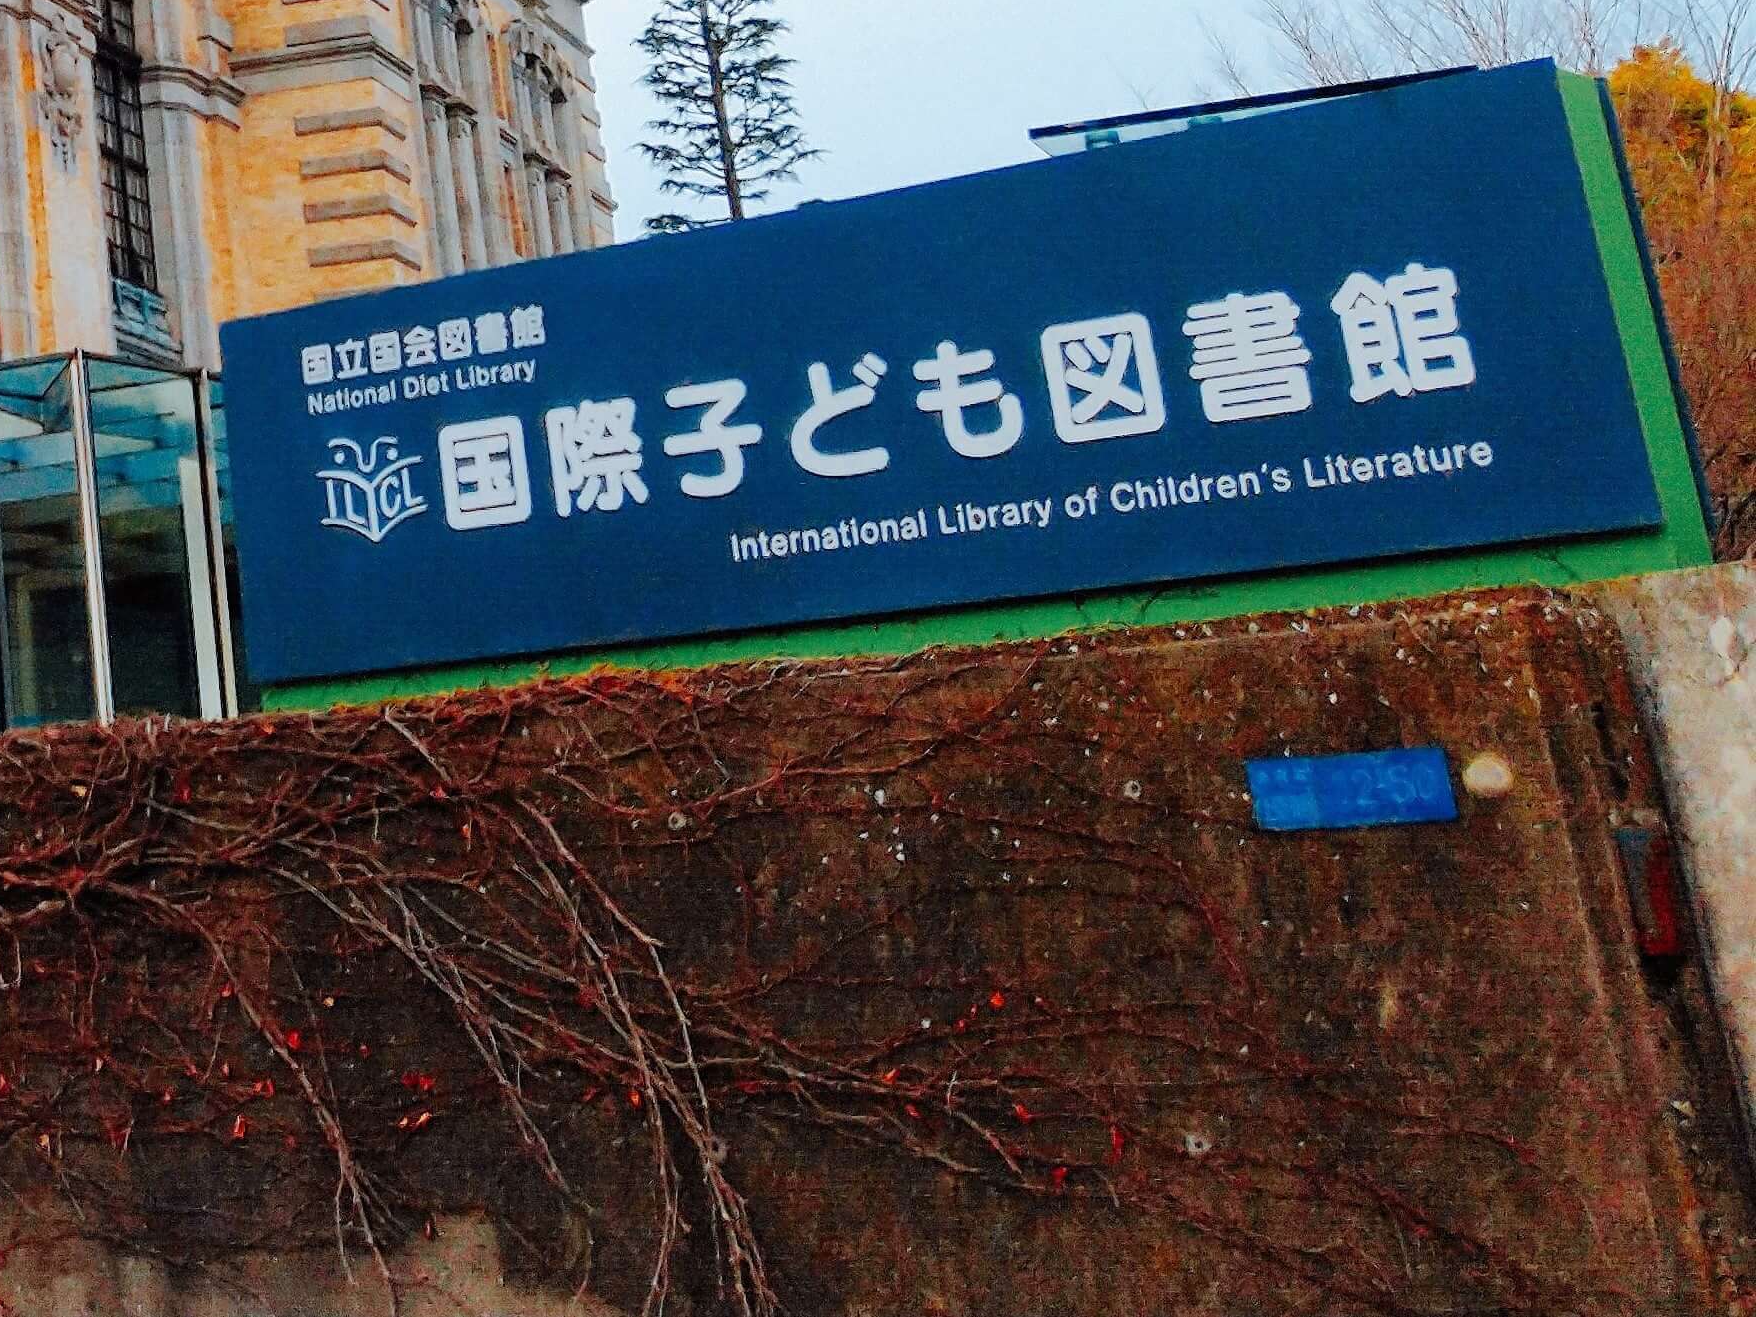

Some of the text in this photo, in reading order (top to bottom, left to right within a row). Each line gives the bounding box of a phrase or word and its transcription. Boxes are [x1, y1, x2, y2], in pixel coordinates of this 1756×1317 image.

[301, 303, 546, 385] 国立国会図書館
[307, 359, 536, 415] National Diet Library
[437, 262, 1478, 531] 国際子ども図書館
[731, 508, 928, 562] International
[937, 498, 1052, 534] Library
[1064, 485, 1098, 518] of
[1303, 441, 1493, 488] Literature
